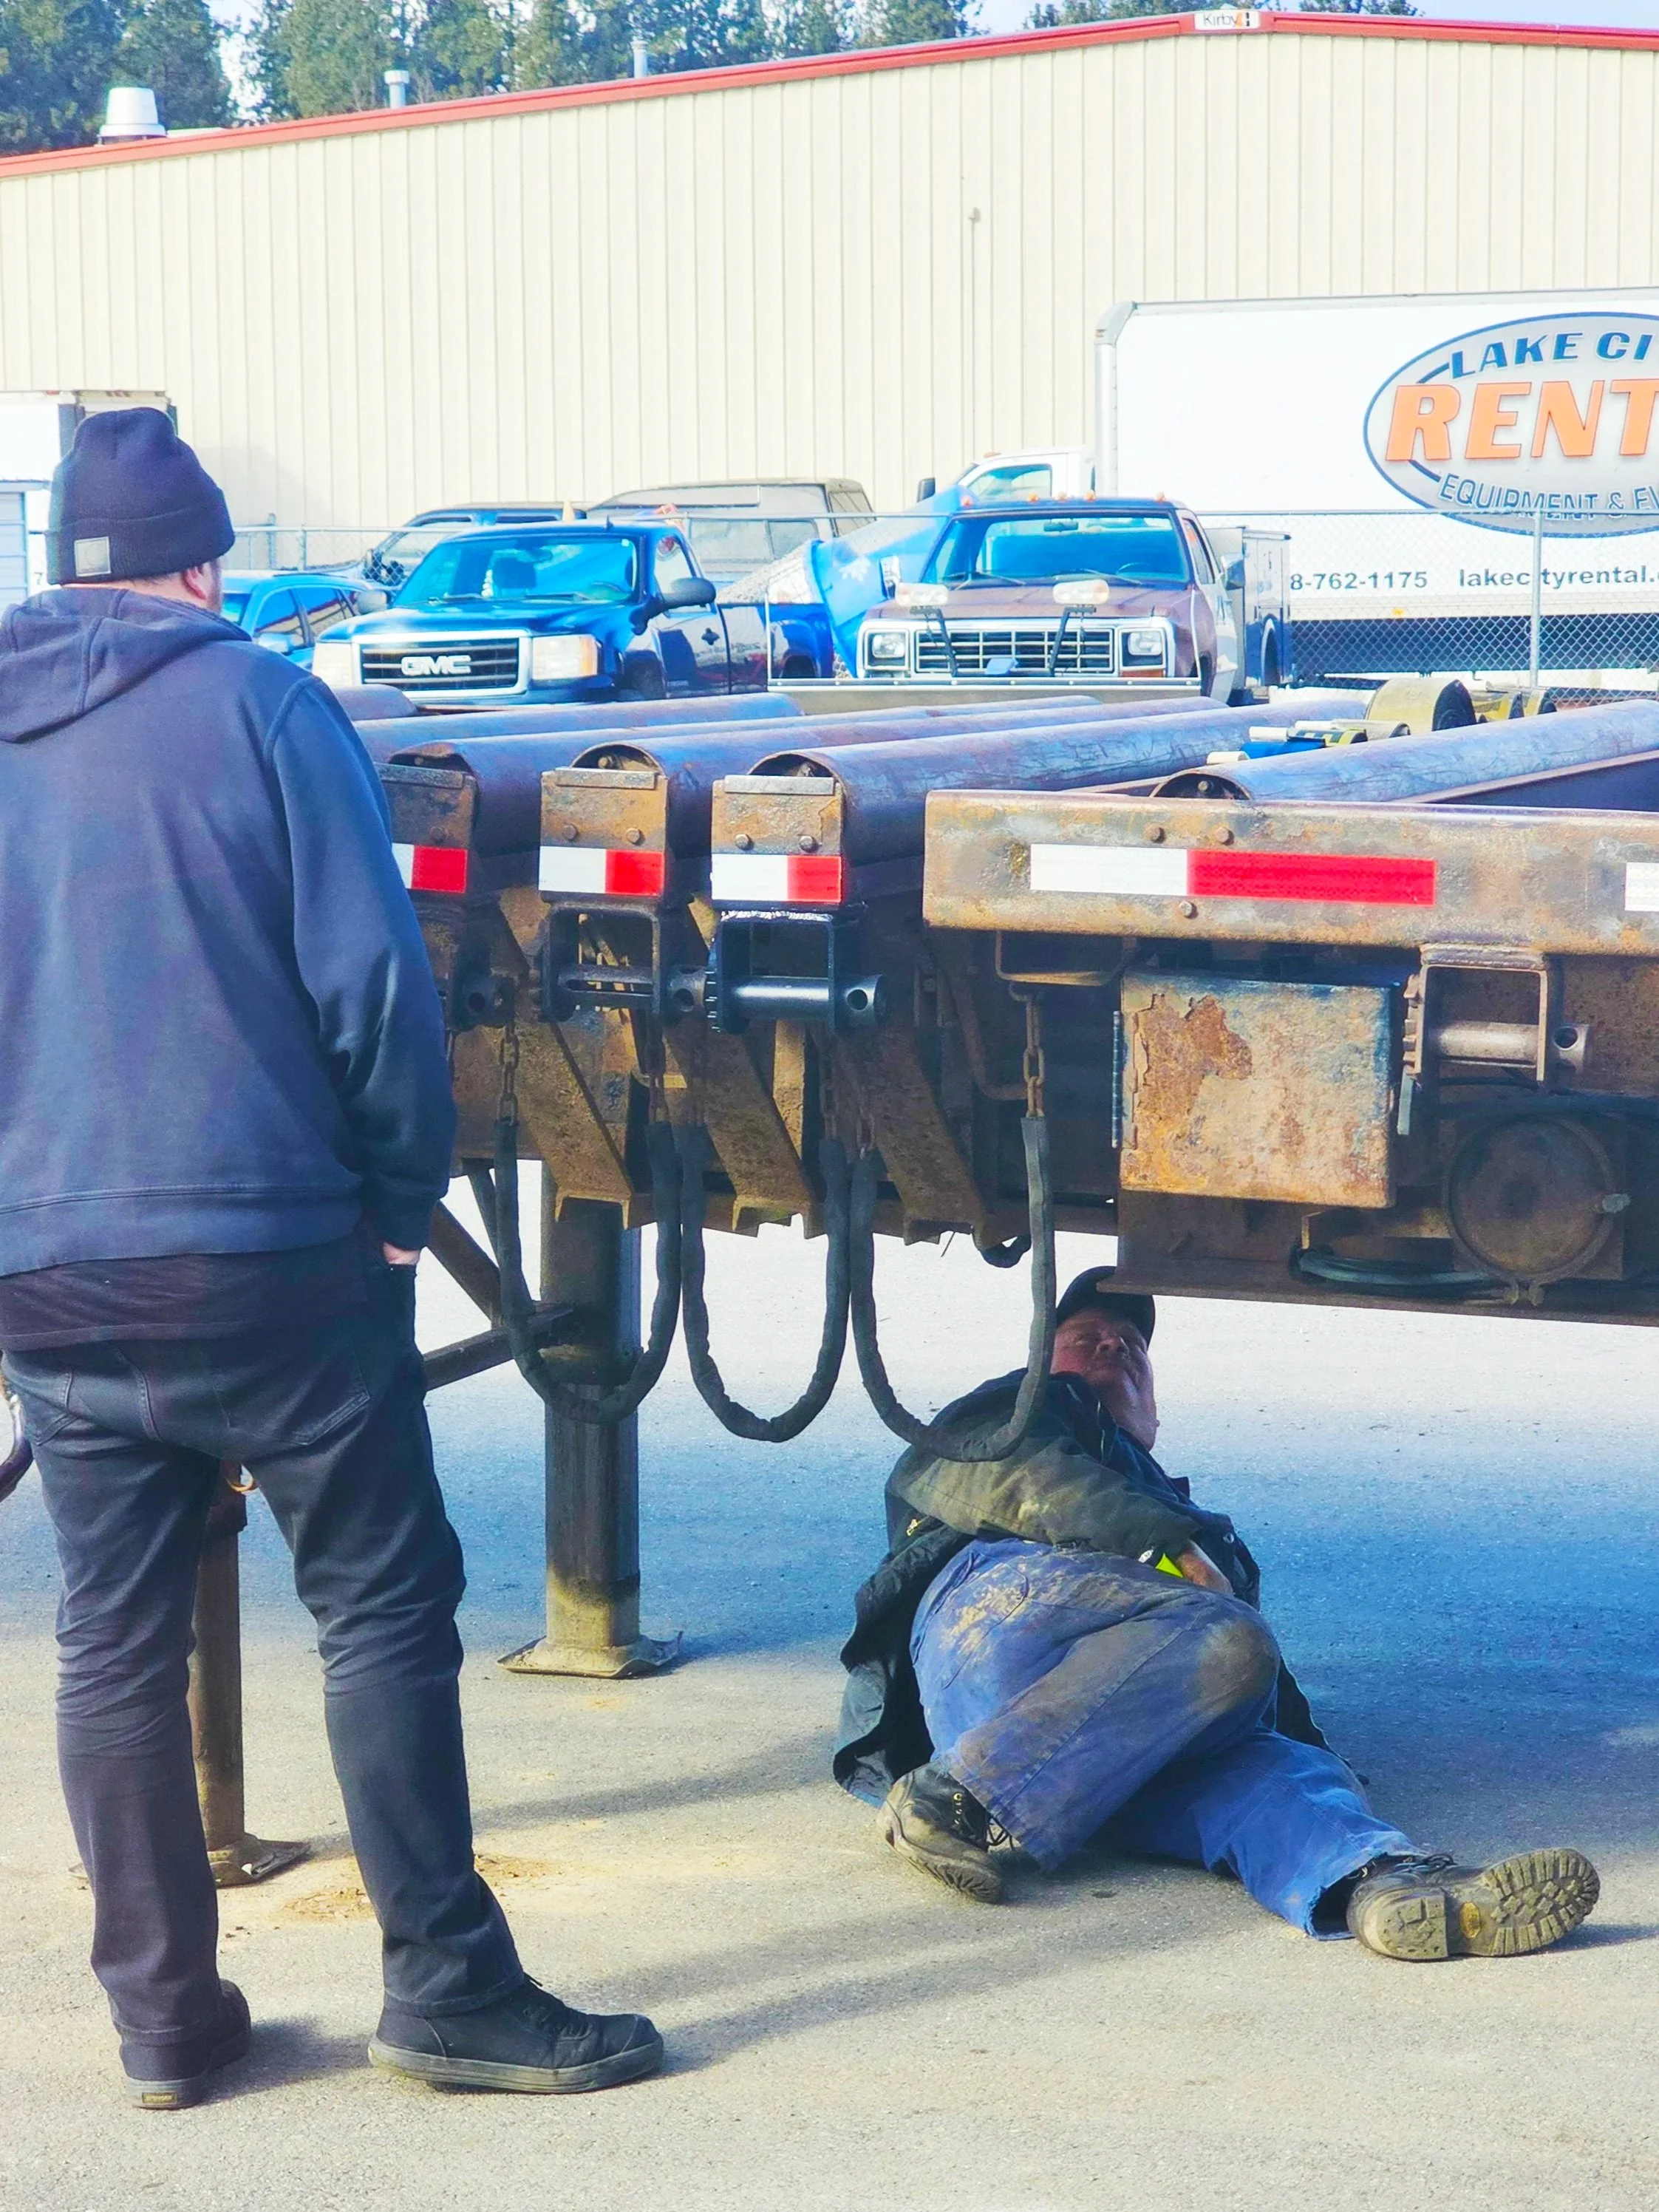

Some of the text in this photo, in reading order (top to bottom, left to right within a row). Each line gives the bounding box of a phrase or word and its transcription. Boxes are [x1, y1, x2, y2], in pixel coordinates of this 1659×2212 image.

[1202, 13, 1239, 27] Kirby
[1451, 333, 1583, 379] LAKE
[1385, 378, 1659, 461] RENT
[1440, 473, 1598, 519] EQUIPMENT
[1608, 491, 1624, 517] &
[1459, 565, 1659, 589] lakectyrental.
[401, 655, 471, 675] GMC
